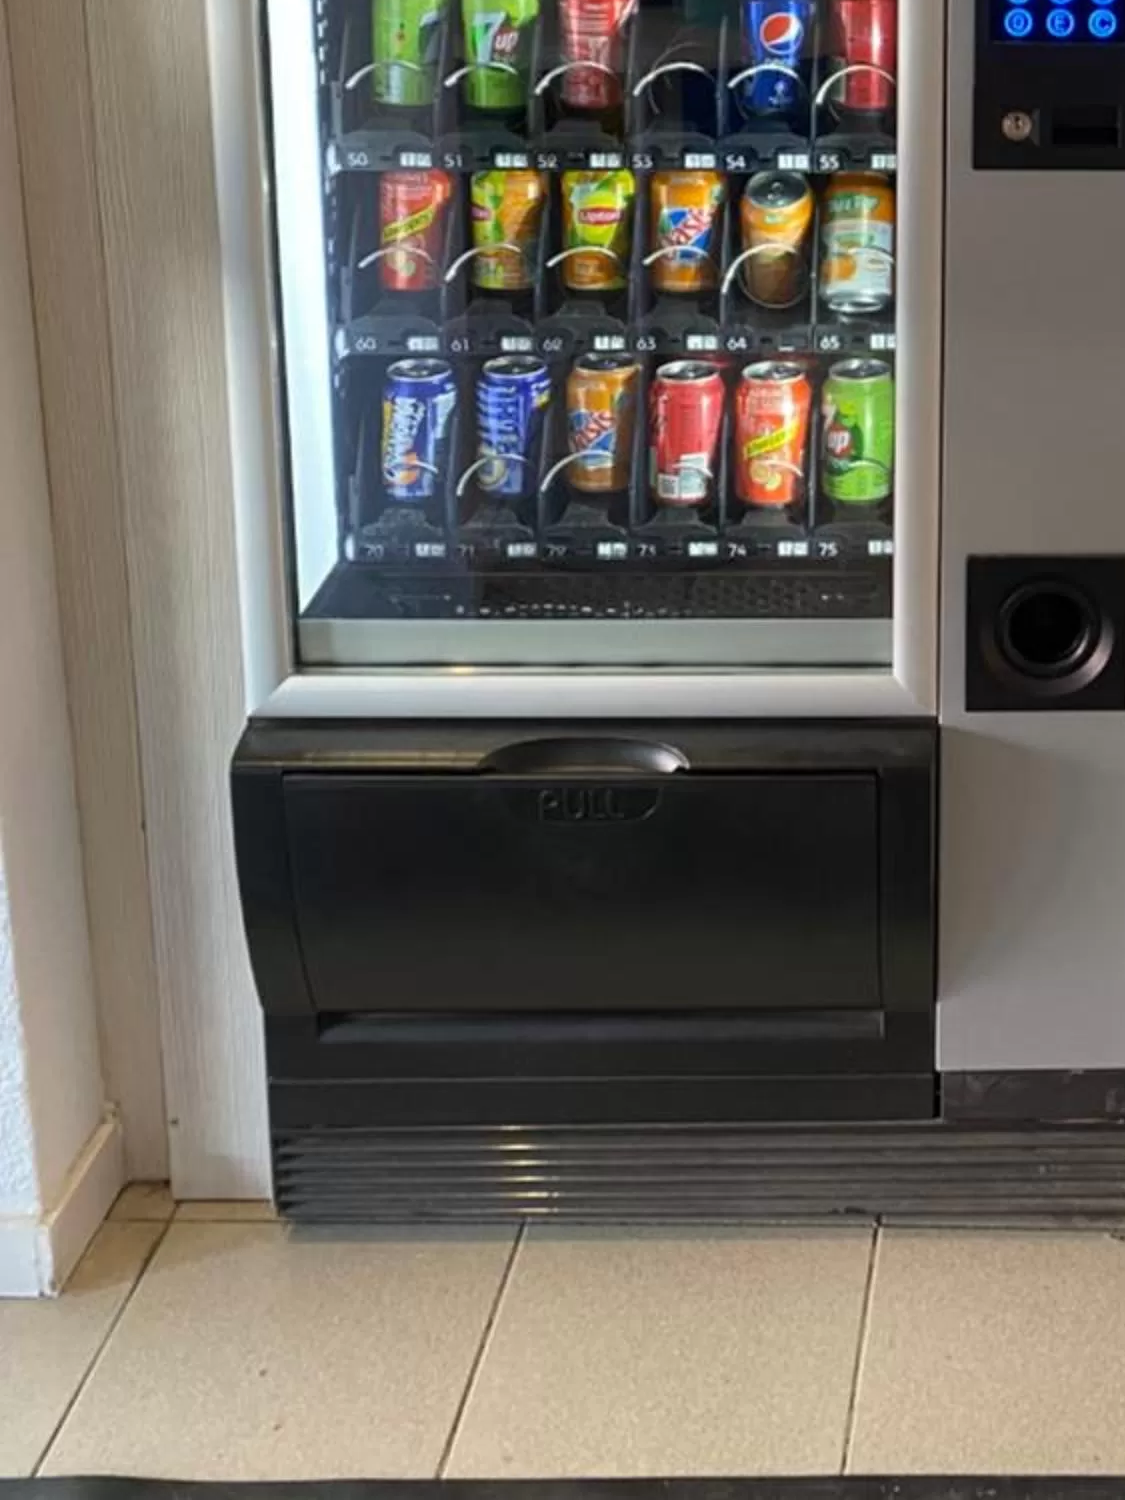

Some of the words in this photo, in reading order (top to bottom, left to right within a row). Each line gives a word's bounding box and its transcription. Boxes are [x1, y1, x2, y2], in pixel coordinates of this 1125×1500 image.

[348, 153, 368, 166] 50
[444, 153, 462, 167] 51
[538, 154, 557, 167] 52
[632, 154, 652, 168] 53
[726, 155, 746, 169] 54
[819, 155, 839, 170] 55
[355, 338, 376, 350] 60
[451, 338, 469, 351] 61
[542, 338, 562, 351] 62
[636, 337, 656, 350] 63
[727, 337, 747, 350] 64
[820, 336, 840, 350] 65
[537, 788, 625, 821] PULL
